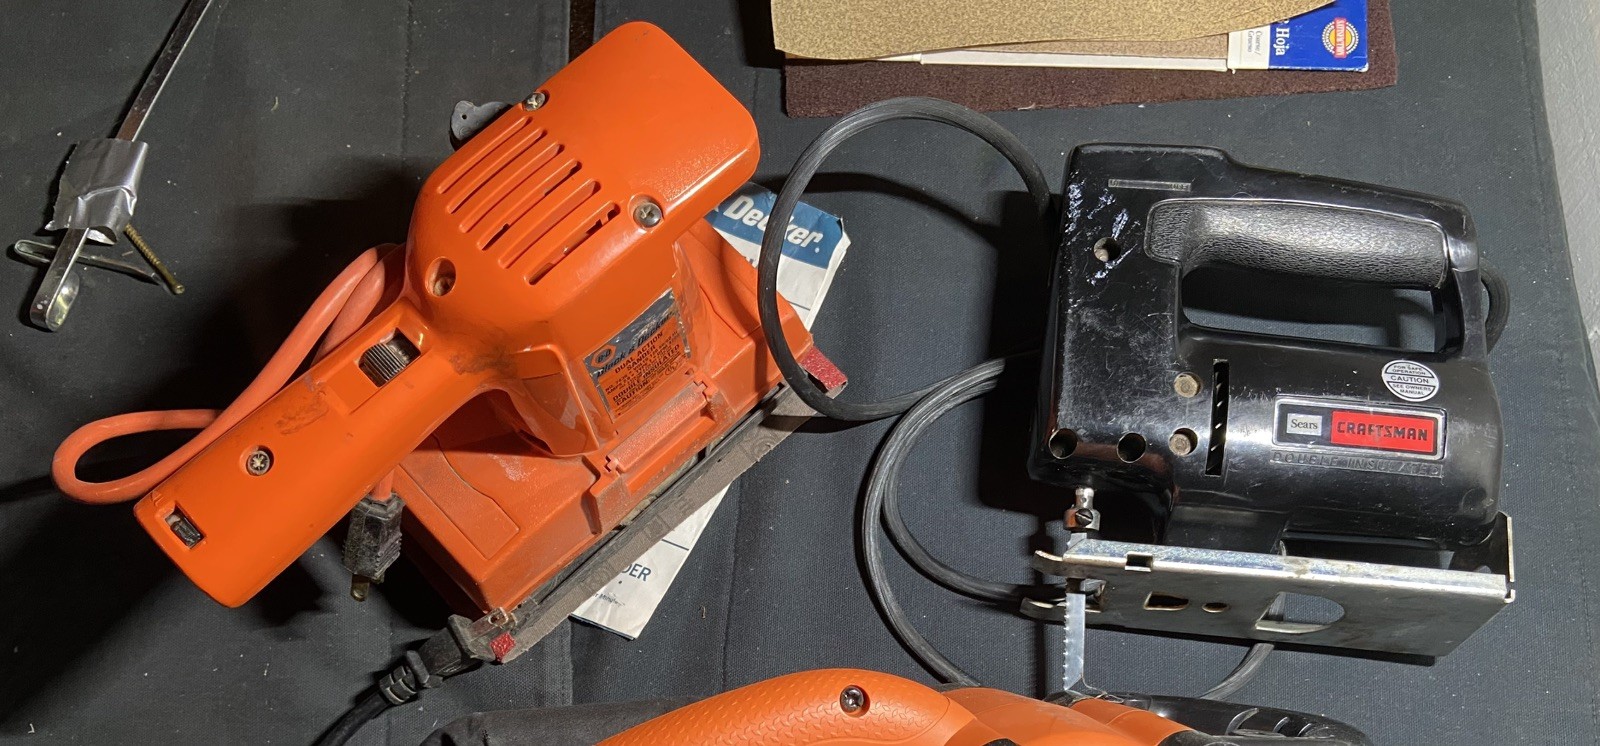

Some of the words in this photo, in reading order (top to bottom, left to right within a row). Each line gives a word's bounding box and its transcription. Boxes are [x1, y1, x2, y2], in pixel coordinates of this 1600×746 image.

[1273, 28, 1290, 56] Hoja
[614, 356, 634, 374] DUAL
[637, 331, 663, 356] ACTION
[627, 345, 656, 371] SANDER
[642, 343, 680, 379] INSULATED
[1390, 375, 1429, 384] CAUTION
[1290, 418, 1319, 430] Sears
[1336, 421, 1428, 441] CRAFTSMAN
[1272, 450, 1340, 466] DOUBLE
